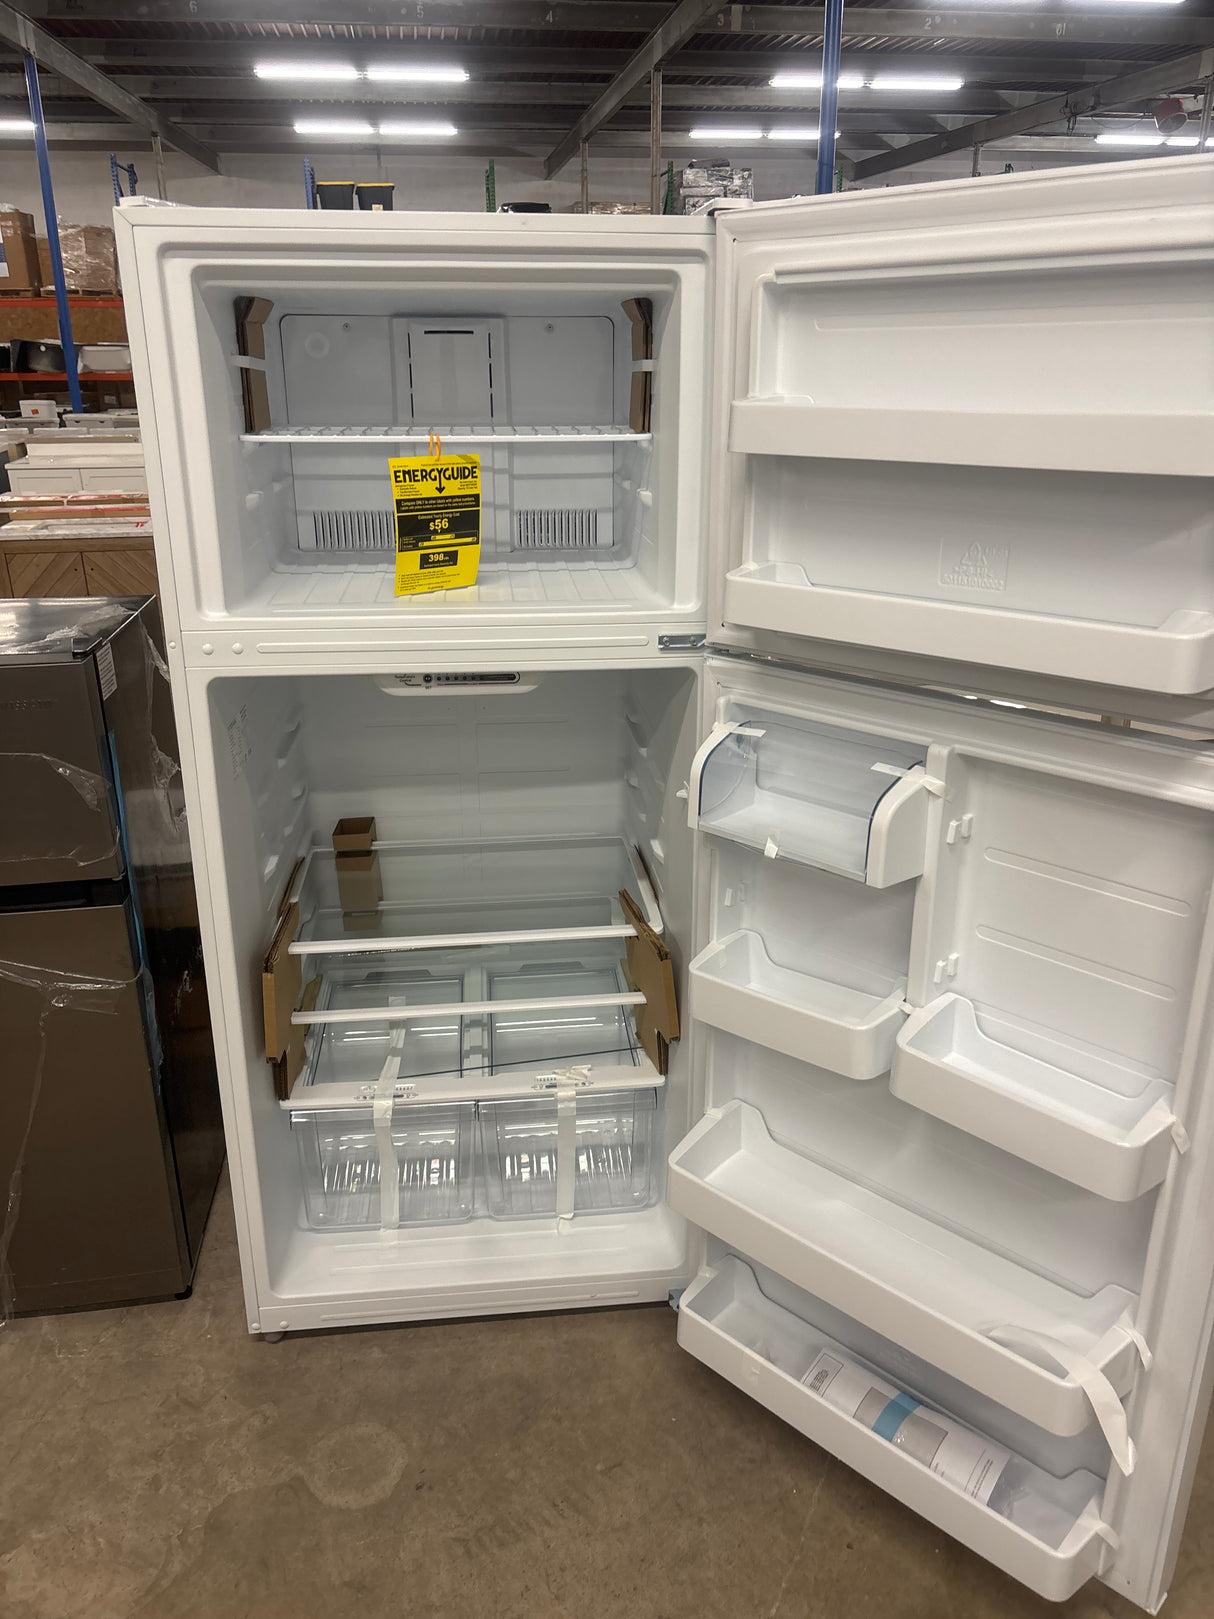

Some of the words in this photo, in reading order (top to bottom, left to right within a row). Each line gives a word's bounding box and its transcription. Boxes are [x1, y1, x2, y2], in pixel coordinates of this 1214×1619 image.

[189, 0, 198, 13] 6
[717, 13, 724, 26] 3
[924, 17, 932, 30] 2
[394, 466, 478, 483] ENERGYGUIDE
[429, 519, 448, 531] $56
[428, 554, 443, 562] 398
